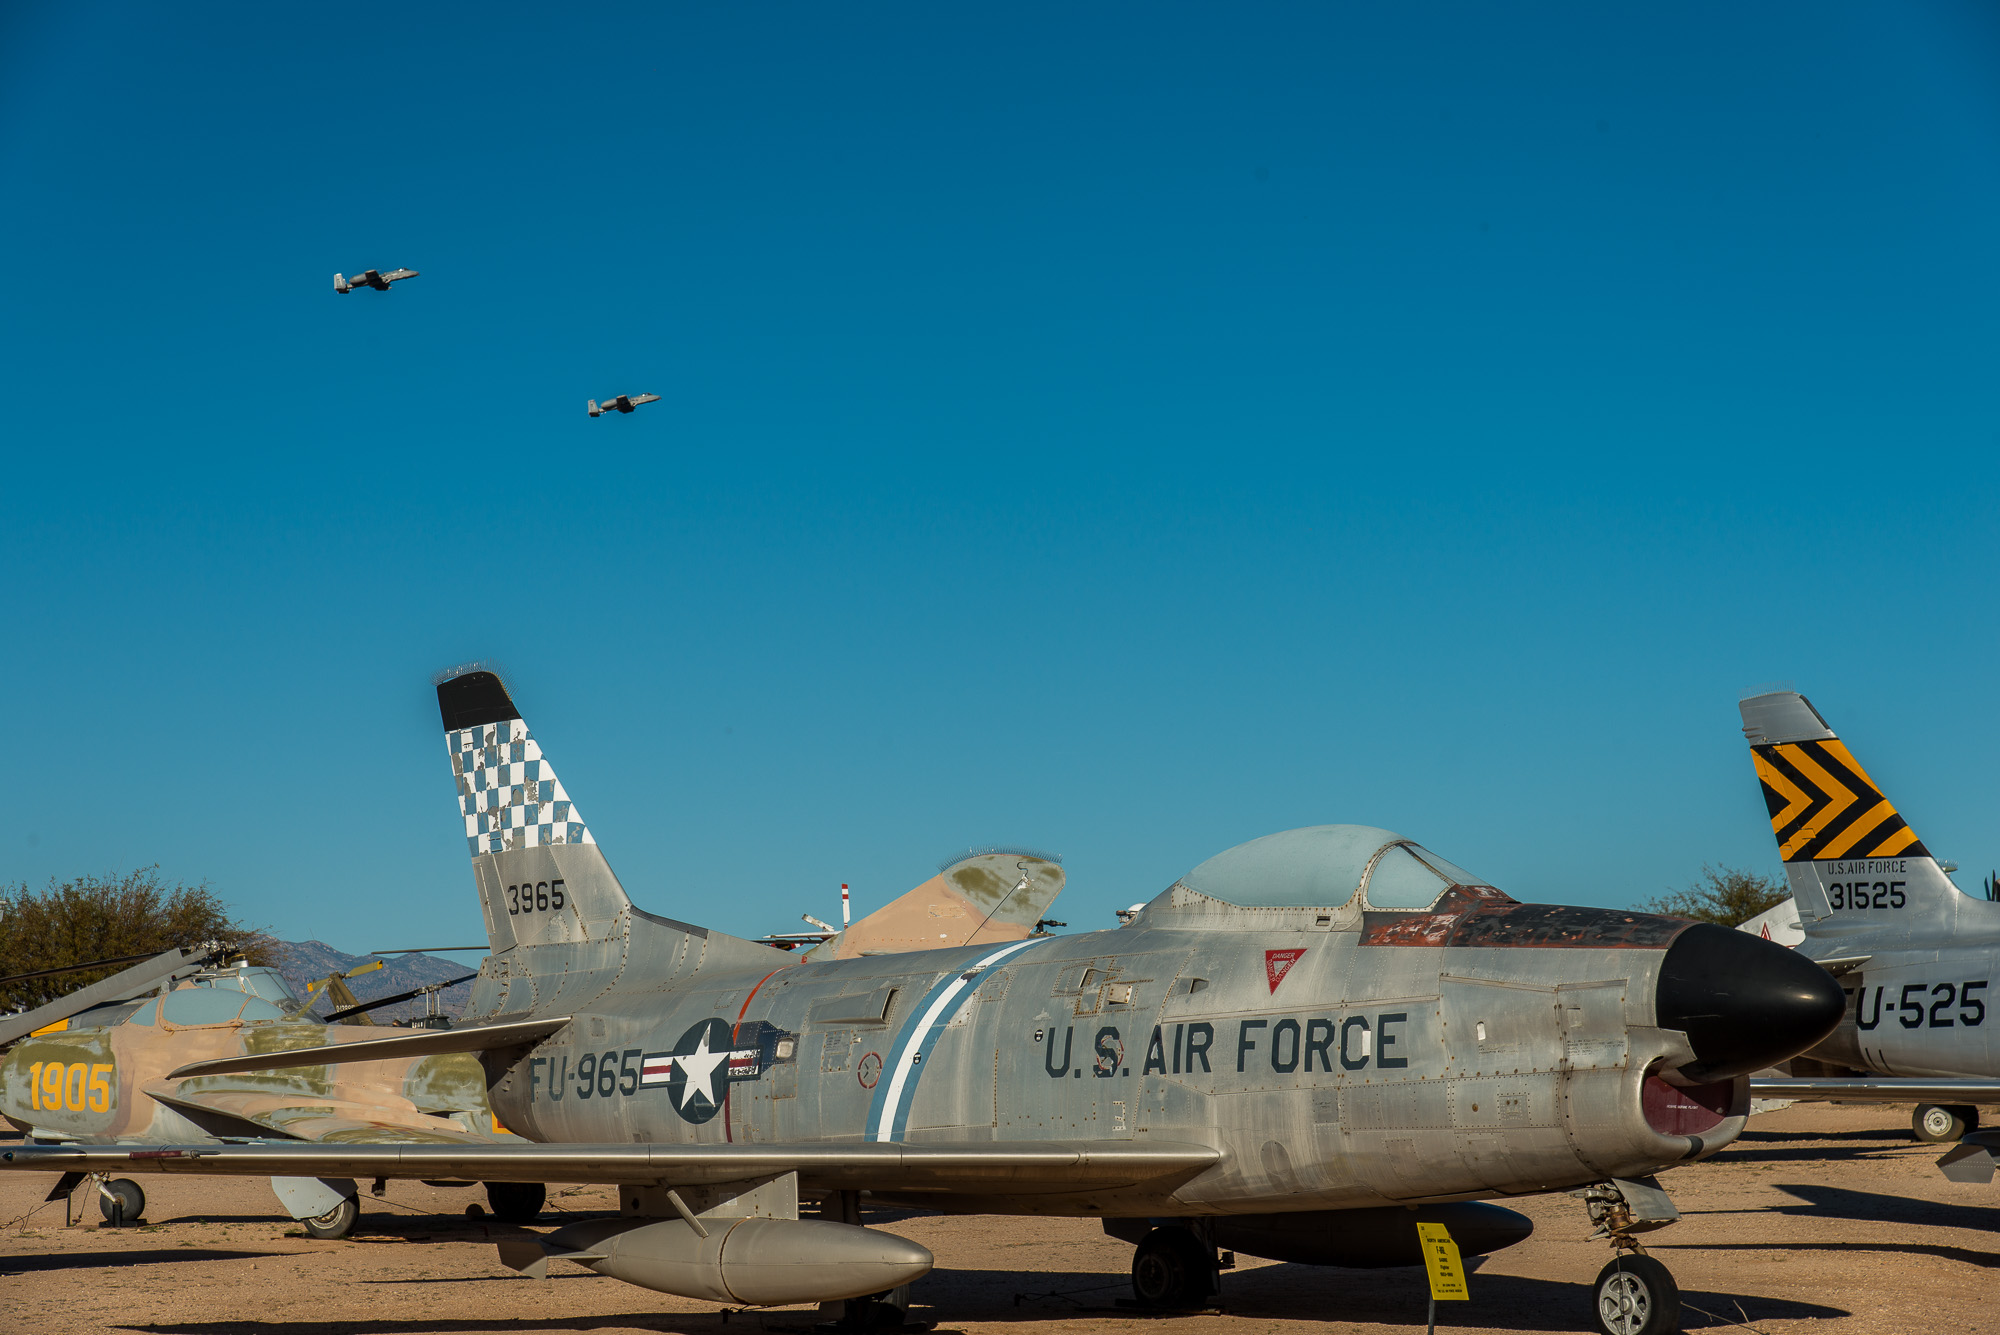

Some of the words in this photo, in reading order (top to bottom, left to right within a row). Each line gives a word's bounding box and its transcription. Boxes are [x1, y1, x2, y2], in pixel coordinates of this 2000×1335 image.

[1868, 860, 1907, 874] FORCE
[507, 879, 565, 916] 3965
[1829, 881, 1906, 910] 31525
[1275, 958, 1297, 983] DANGER
[1142, 1022, 1215, 1076] AIR
[1236, 1012, 1409, 1074] FORCE
[29, 1061, 114, 1113] 1905
[529, 1048, 643, 1104] FU-965
